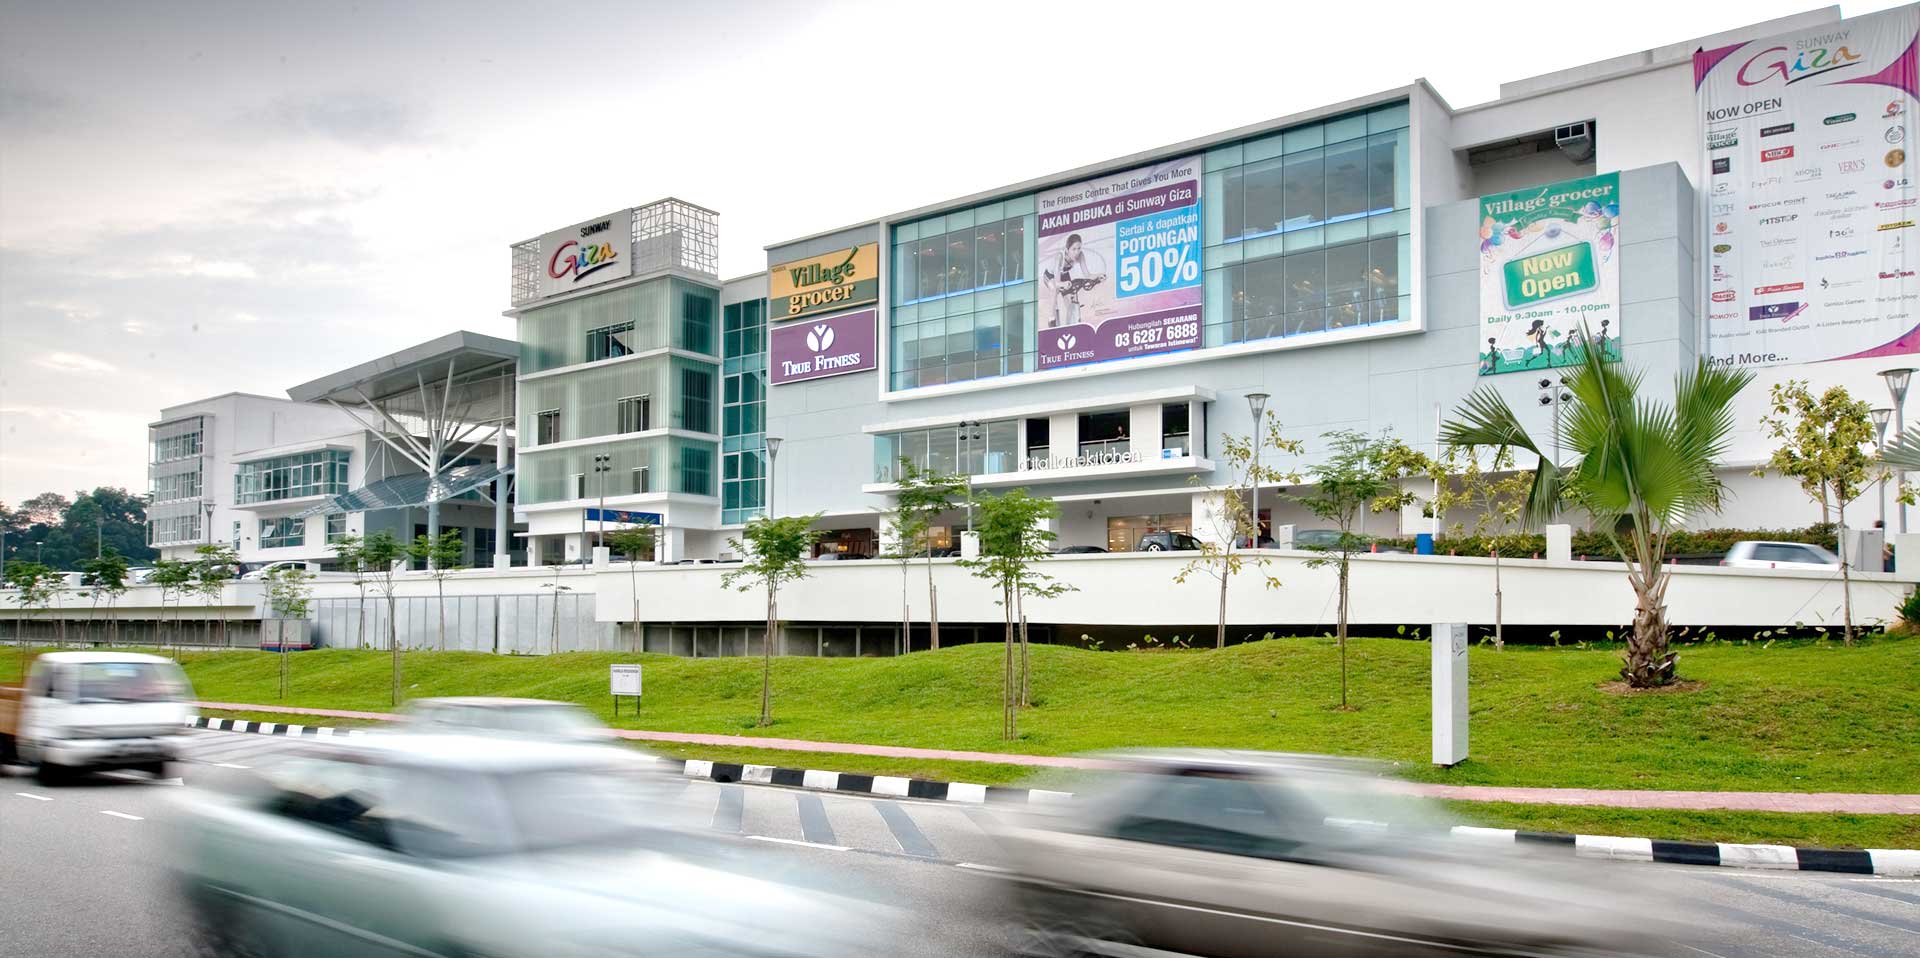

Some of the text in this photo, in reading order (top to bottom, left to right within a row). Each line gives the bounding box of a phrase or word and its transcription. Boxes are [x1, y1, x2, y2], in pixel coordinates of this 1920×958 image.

[1796, 30, 1850, 50] SUNWAY
[1737, 46, 1861, 86] Giza
[1706, 97, 1782, 121] NOW OPEN
[1042, 167, 1192, 209] The Fitness Centre That Gives You More
[1485, 185, 1613, 215] Village grocer
[1041, 187, 1192, 230] AKAN DIBUKA di Sunway Giza
[580, 219, 611, 237] SUNWAY
[1119, 213, 1198, 237] Sertai & dapatkan
[1119, 225, 1198, 256] POTONGAN
[548, 240, 617, 279] Giza
[790, 250, 856, 288] Village
[1119, 245, 1198, 292] 50%
[1522, 251, 1574, 277] Now
[1521, 271, 1580, 298] Open
[788, 284, 856, 314] grocer
[1163, 314, 1198, 326] SEKARANG
[1487, 314, 1512, 325] Daily
[1515, 309, 1553, 321] 9.30am
[1564, 303, 1611, 315] 10.00pm
[1115, 322, 1198, 348] 03 6287 6888
[1041, 350, 1094, 365] TRUE FITNESS
[1128, 345, 1143, 353] untuk
[1708, 353, 1789, 367] And More...
[782, 352, 861, 376] TRUE FITNESS
